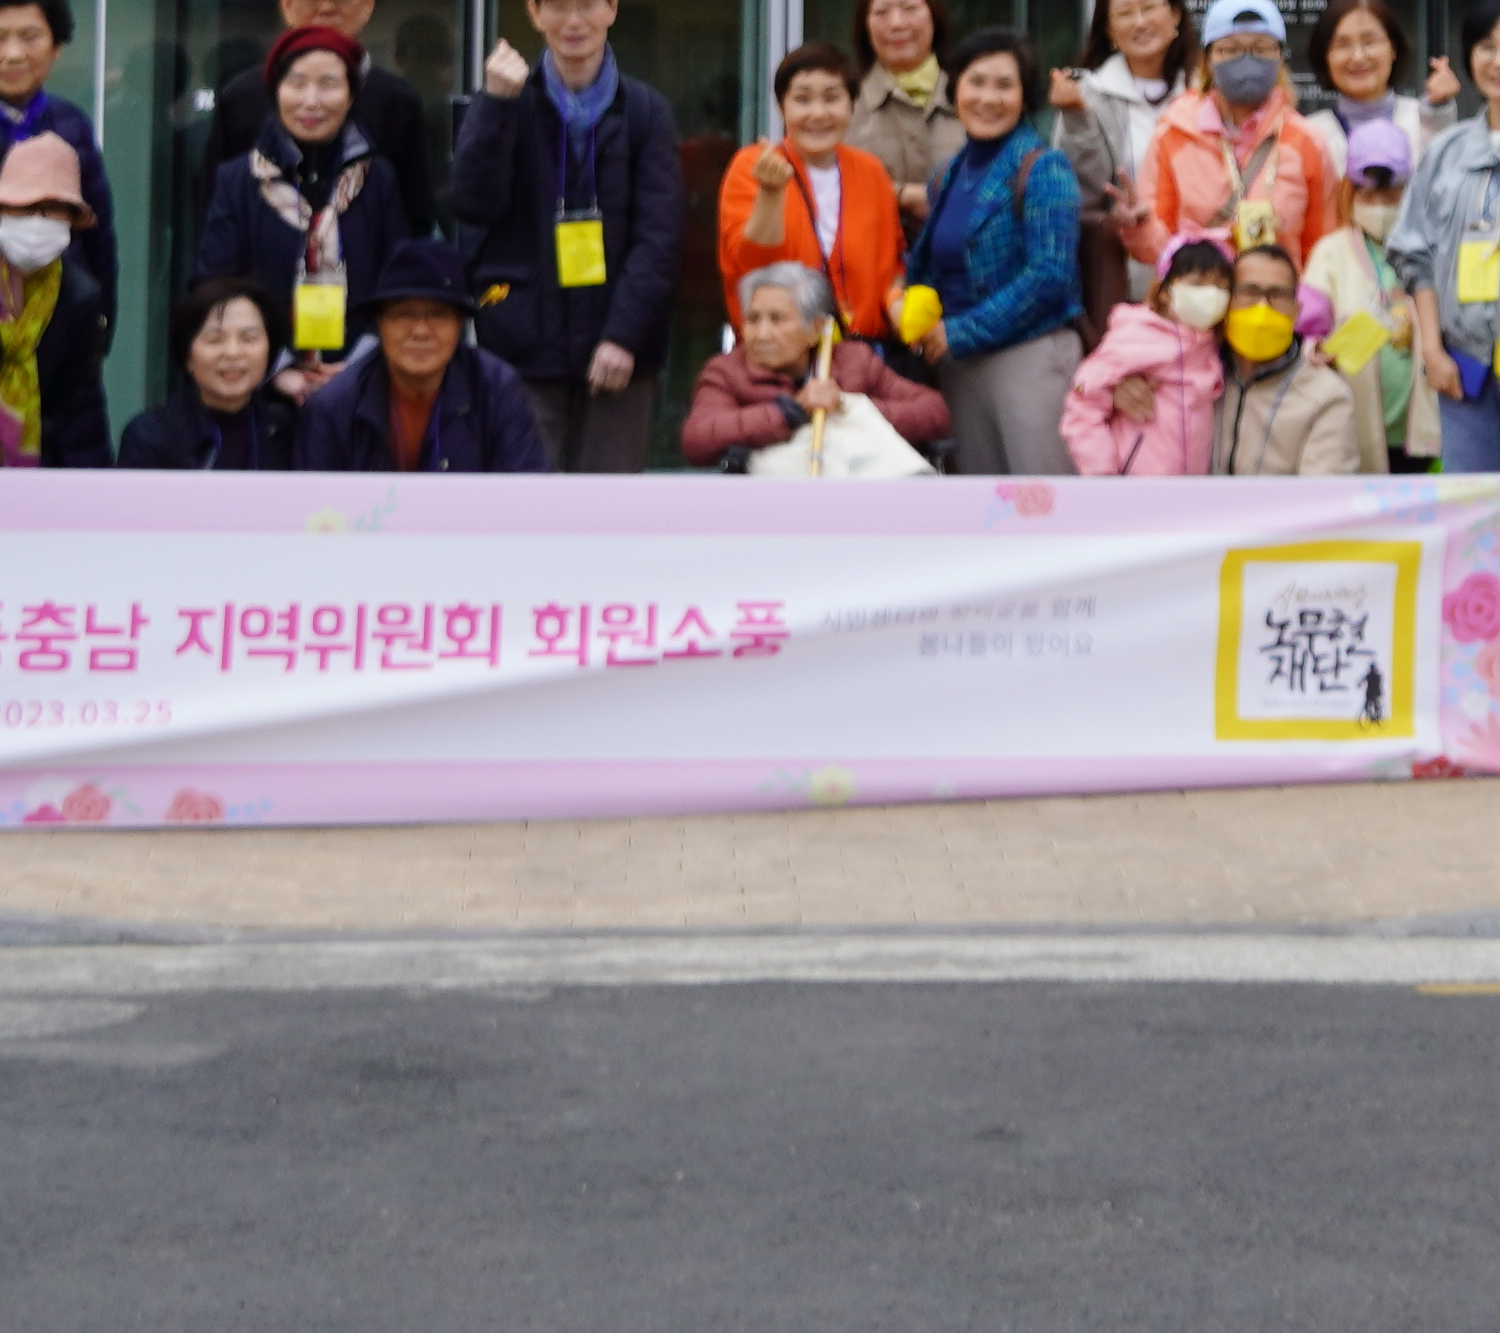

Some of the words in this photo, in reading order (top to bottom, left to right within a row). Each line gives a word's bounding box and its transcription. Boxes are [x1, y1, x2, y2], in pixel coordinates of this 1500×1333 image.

[176, 600, 502, 671] 지역위원회
[529, 598, 788, 669] 회원소풍
[1259, 607, 1377, 657] 노무현
[1268, 645, 1353, 693] 재단
